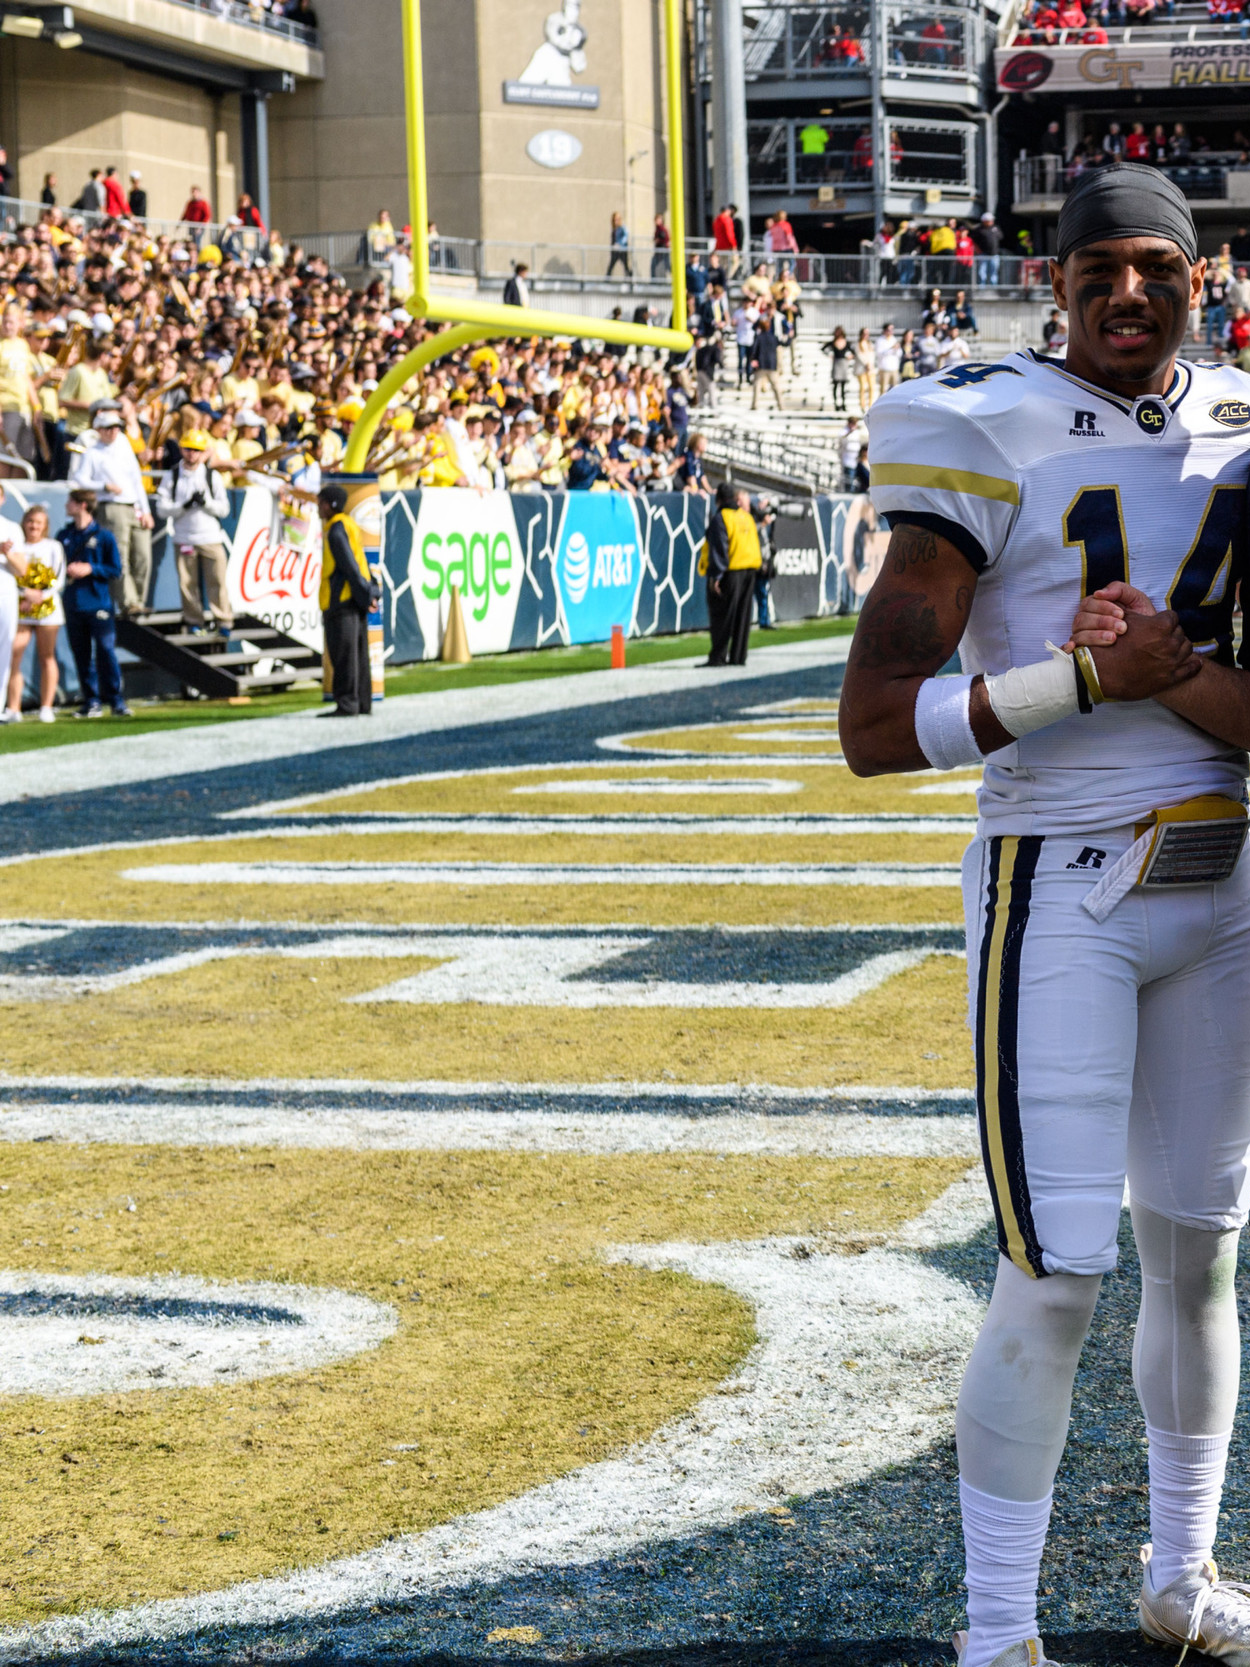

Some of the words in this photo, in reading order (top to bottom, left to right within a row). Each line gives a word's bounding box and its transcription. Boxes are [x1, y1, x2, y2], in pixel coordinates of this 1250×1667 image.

[1140, 409, 1163, 427] GT
[1217, 405, 1250, 417] ACC
[1069, 428, 1106, 438] RUSSELL
[592, 543, 636, 589] AT&T
[421, 531, 513, 622] sage
